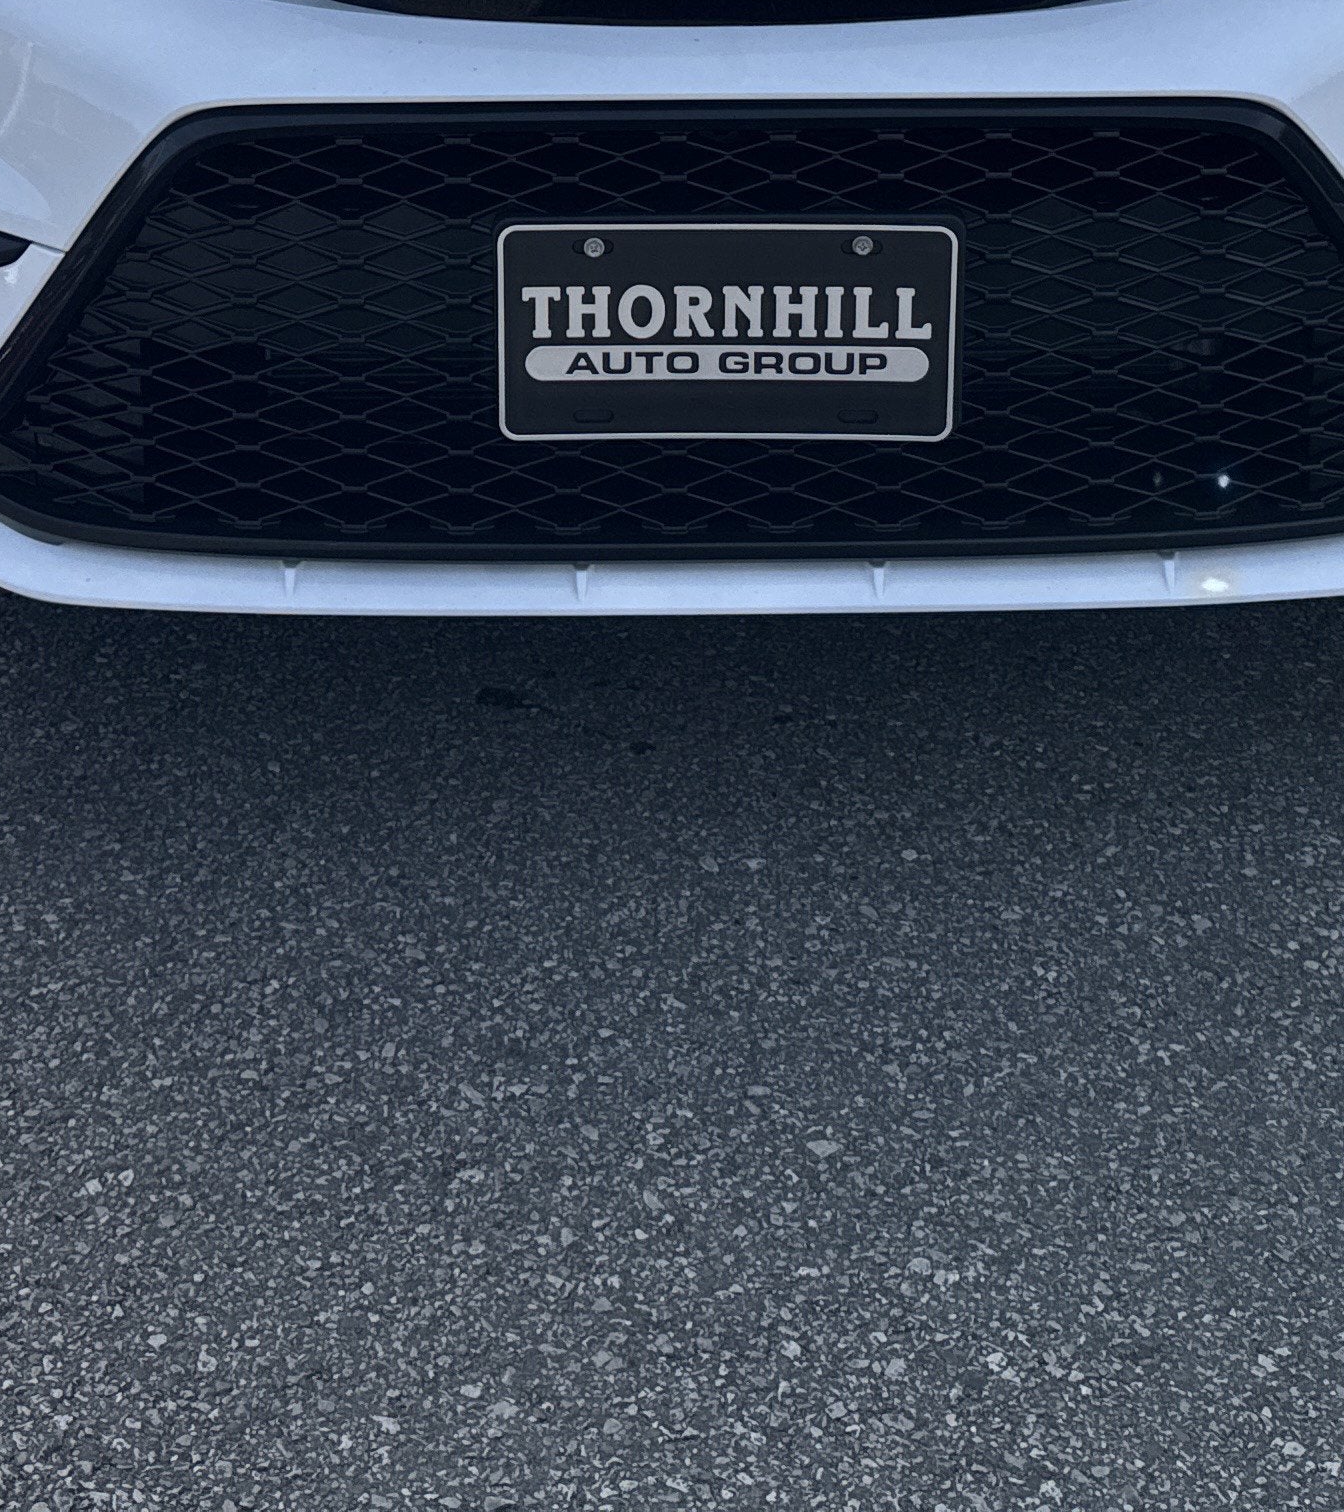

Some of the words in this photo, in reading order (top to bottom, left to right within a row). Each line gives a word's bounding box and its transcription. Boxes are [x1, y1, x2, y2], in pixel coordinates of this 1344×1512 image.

[521, 284, 933, 340] THORNHILL
[565, 351, 701, 375] AUTO
[718, 351, 888, 376] GROUP
